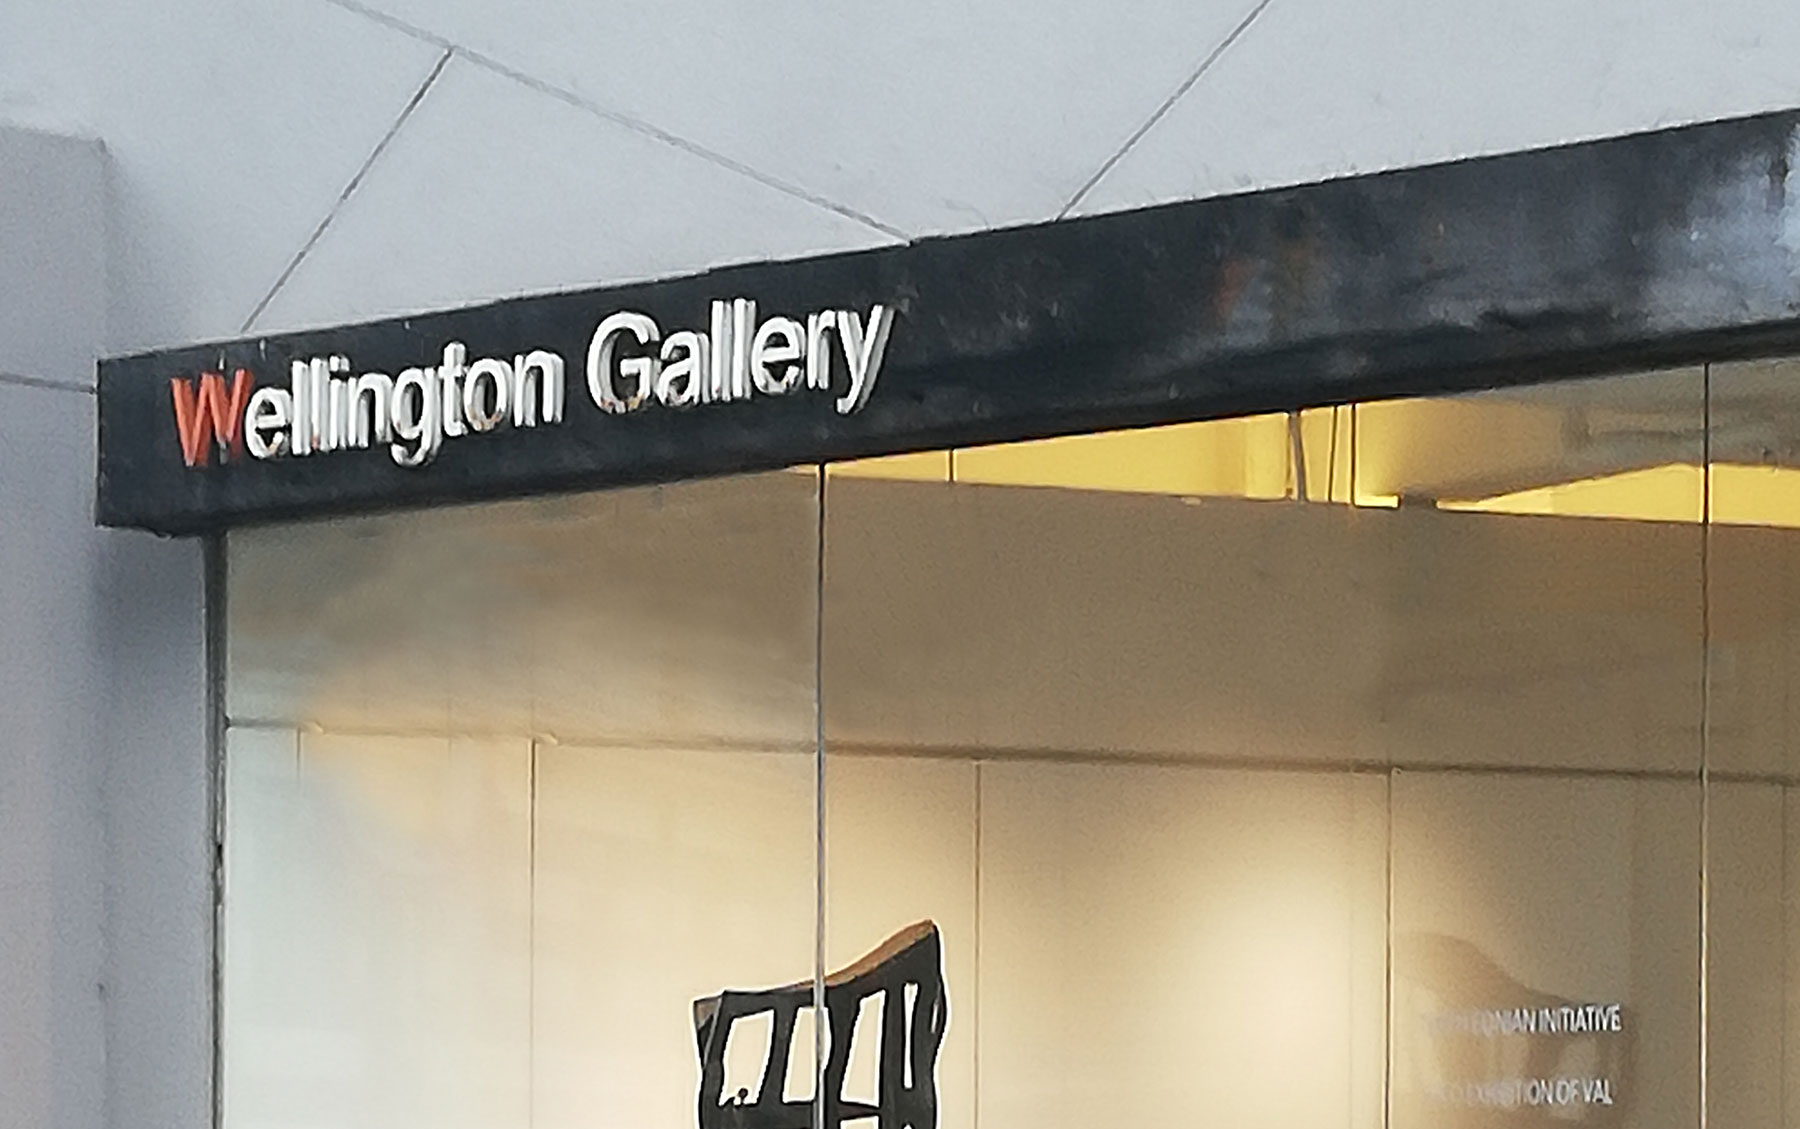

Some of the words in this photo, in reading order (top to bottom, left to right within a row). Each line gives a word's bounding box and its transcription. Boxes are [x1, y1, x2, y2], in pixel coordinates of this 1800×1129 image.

[170, 340, 565, 468] Wellington
[586, 297, 895, 414] Gallery
[1538, 1003, 1622, 1034] INITIATIVE
[1556, 1079, 1579, 1107] OF
[1581, 1078, 1613, 1105] VAL
